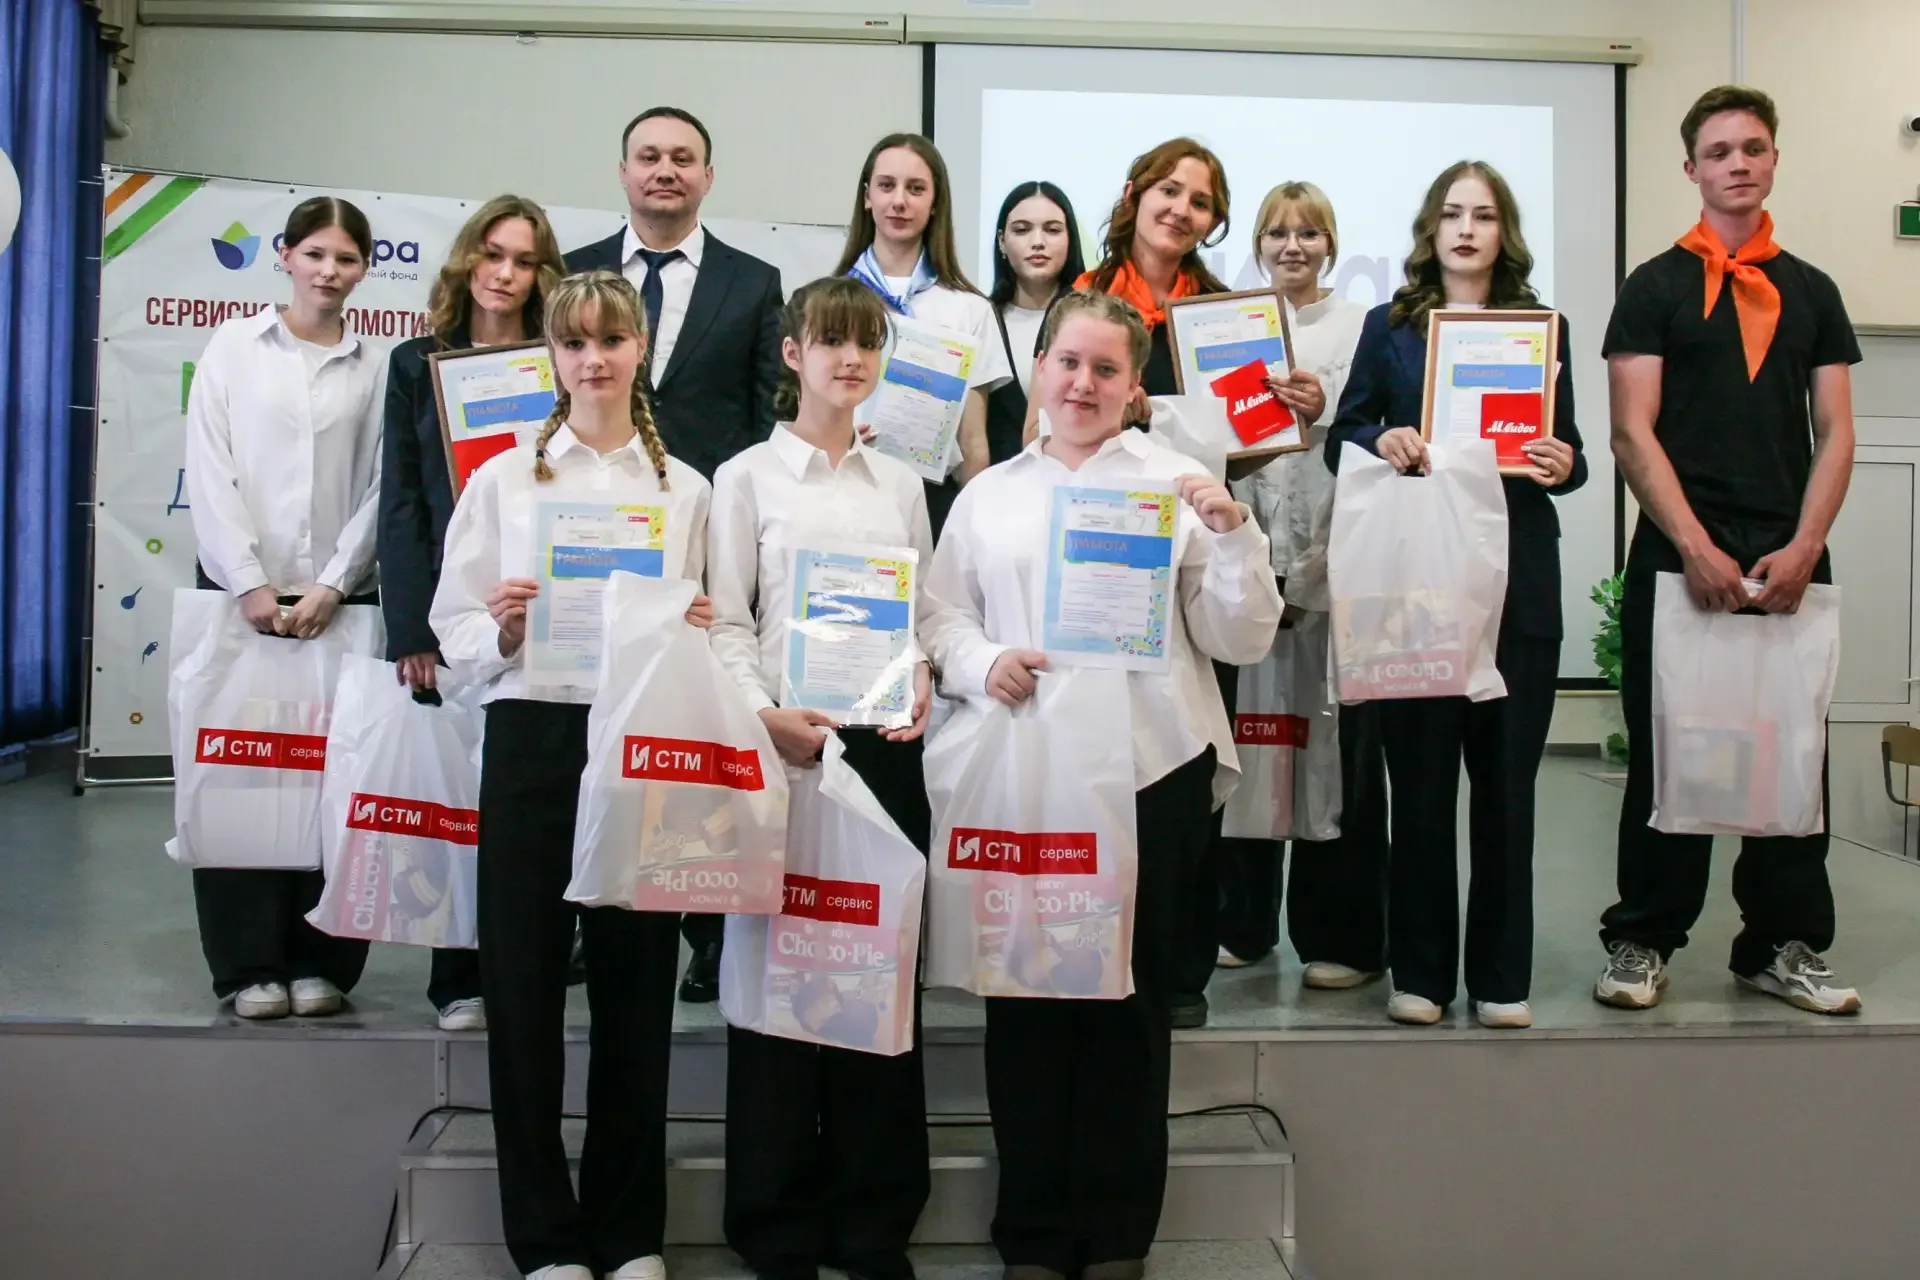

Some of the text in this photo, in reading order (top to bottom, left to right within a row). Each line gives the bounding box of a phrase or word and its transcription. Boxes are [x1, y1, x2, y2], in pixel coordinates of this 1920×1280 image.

[272, 232, 419, 268] сра
[389, 269, 418, 281] фонд
[1487, 421, 1537, 434] М.видео
[1242, 722, 1277, 737] СТМ
[230, 740, 326, 760] СТМ серви
[655, 750, 754, 777] СТМ серс
[380, 807, 422, 826] СТМ
[1039, 847, 1089, 861] сервис
[826, 896, 873, 910] сервис
